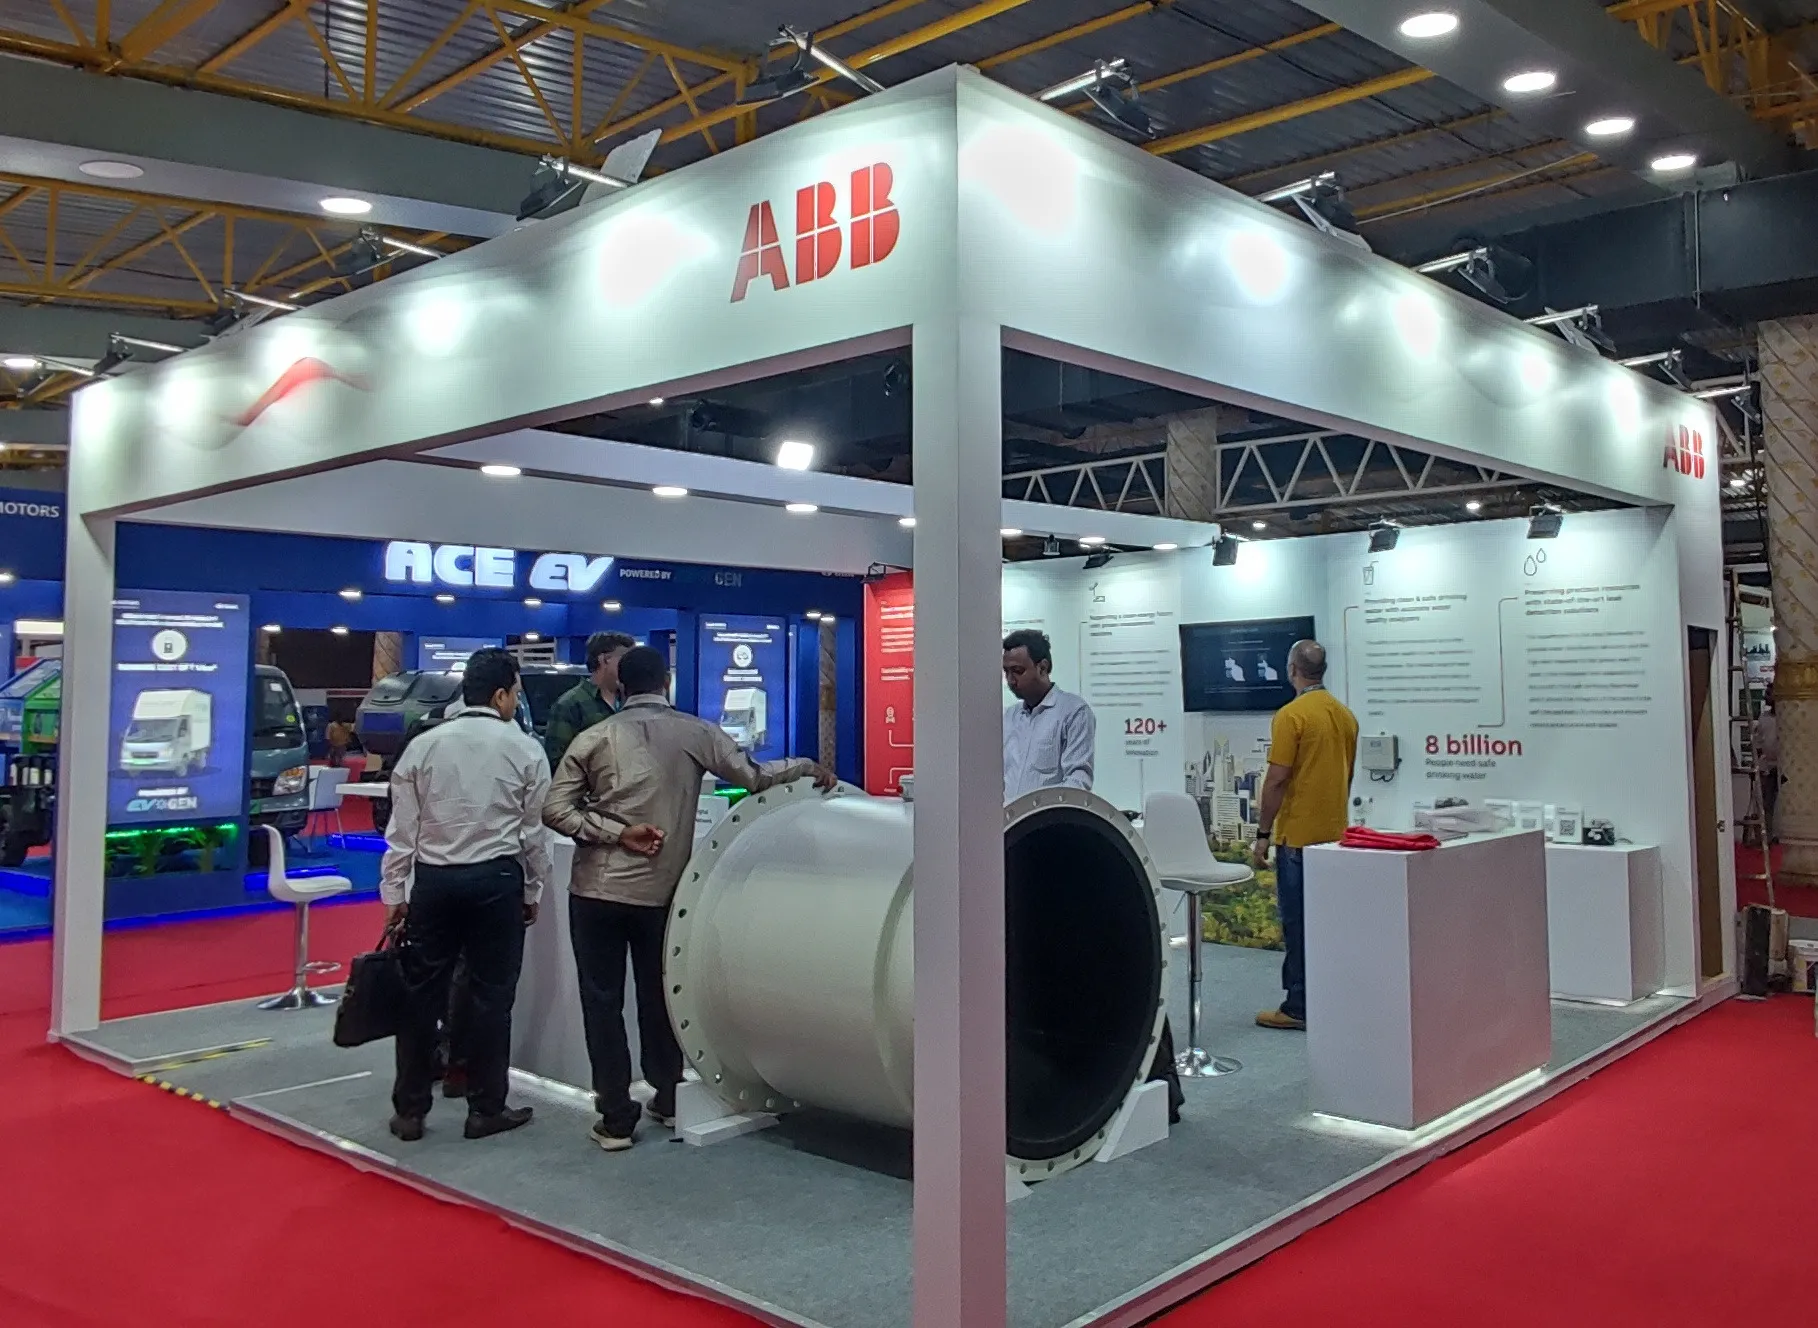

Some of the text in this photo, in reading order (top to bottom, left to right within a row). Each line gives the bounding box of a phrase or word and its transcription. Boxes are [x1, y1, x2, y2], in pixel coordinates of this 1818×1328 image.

[730, 162, 900, 304] ABB
[1663, 421, 1705, 479] ABB
[386, 541, 614, 591] ACE EV
[619, 569, 673, 580] POWERED BY
[1124, 717, 1167, 735] 120+
[1425, 733, 1523, 755] 8 billion
[1477, 759, 1497, 768] safe
[1426, 771, 1487, 780] drinking water
